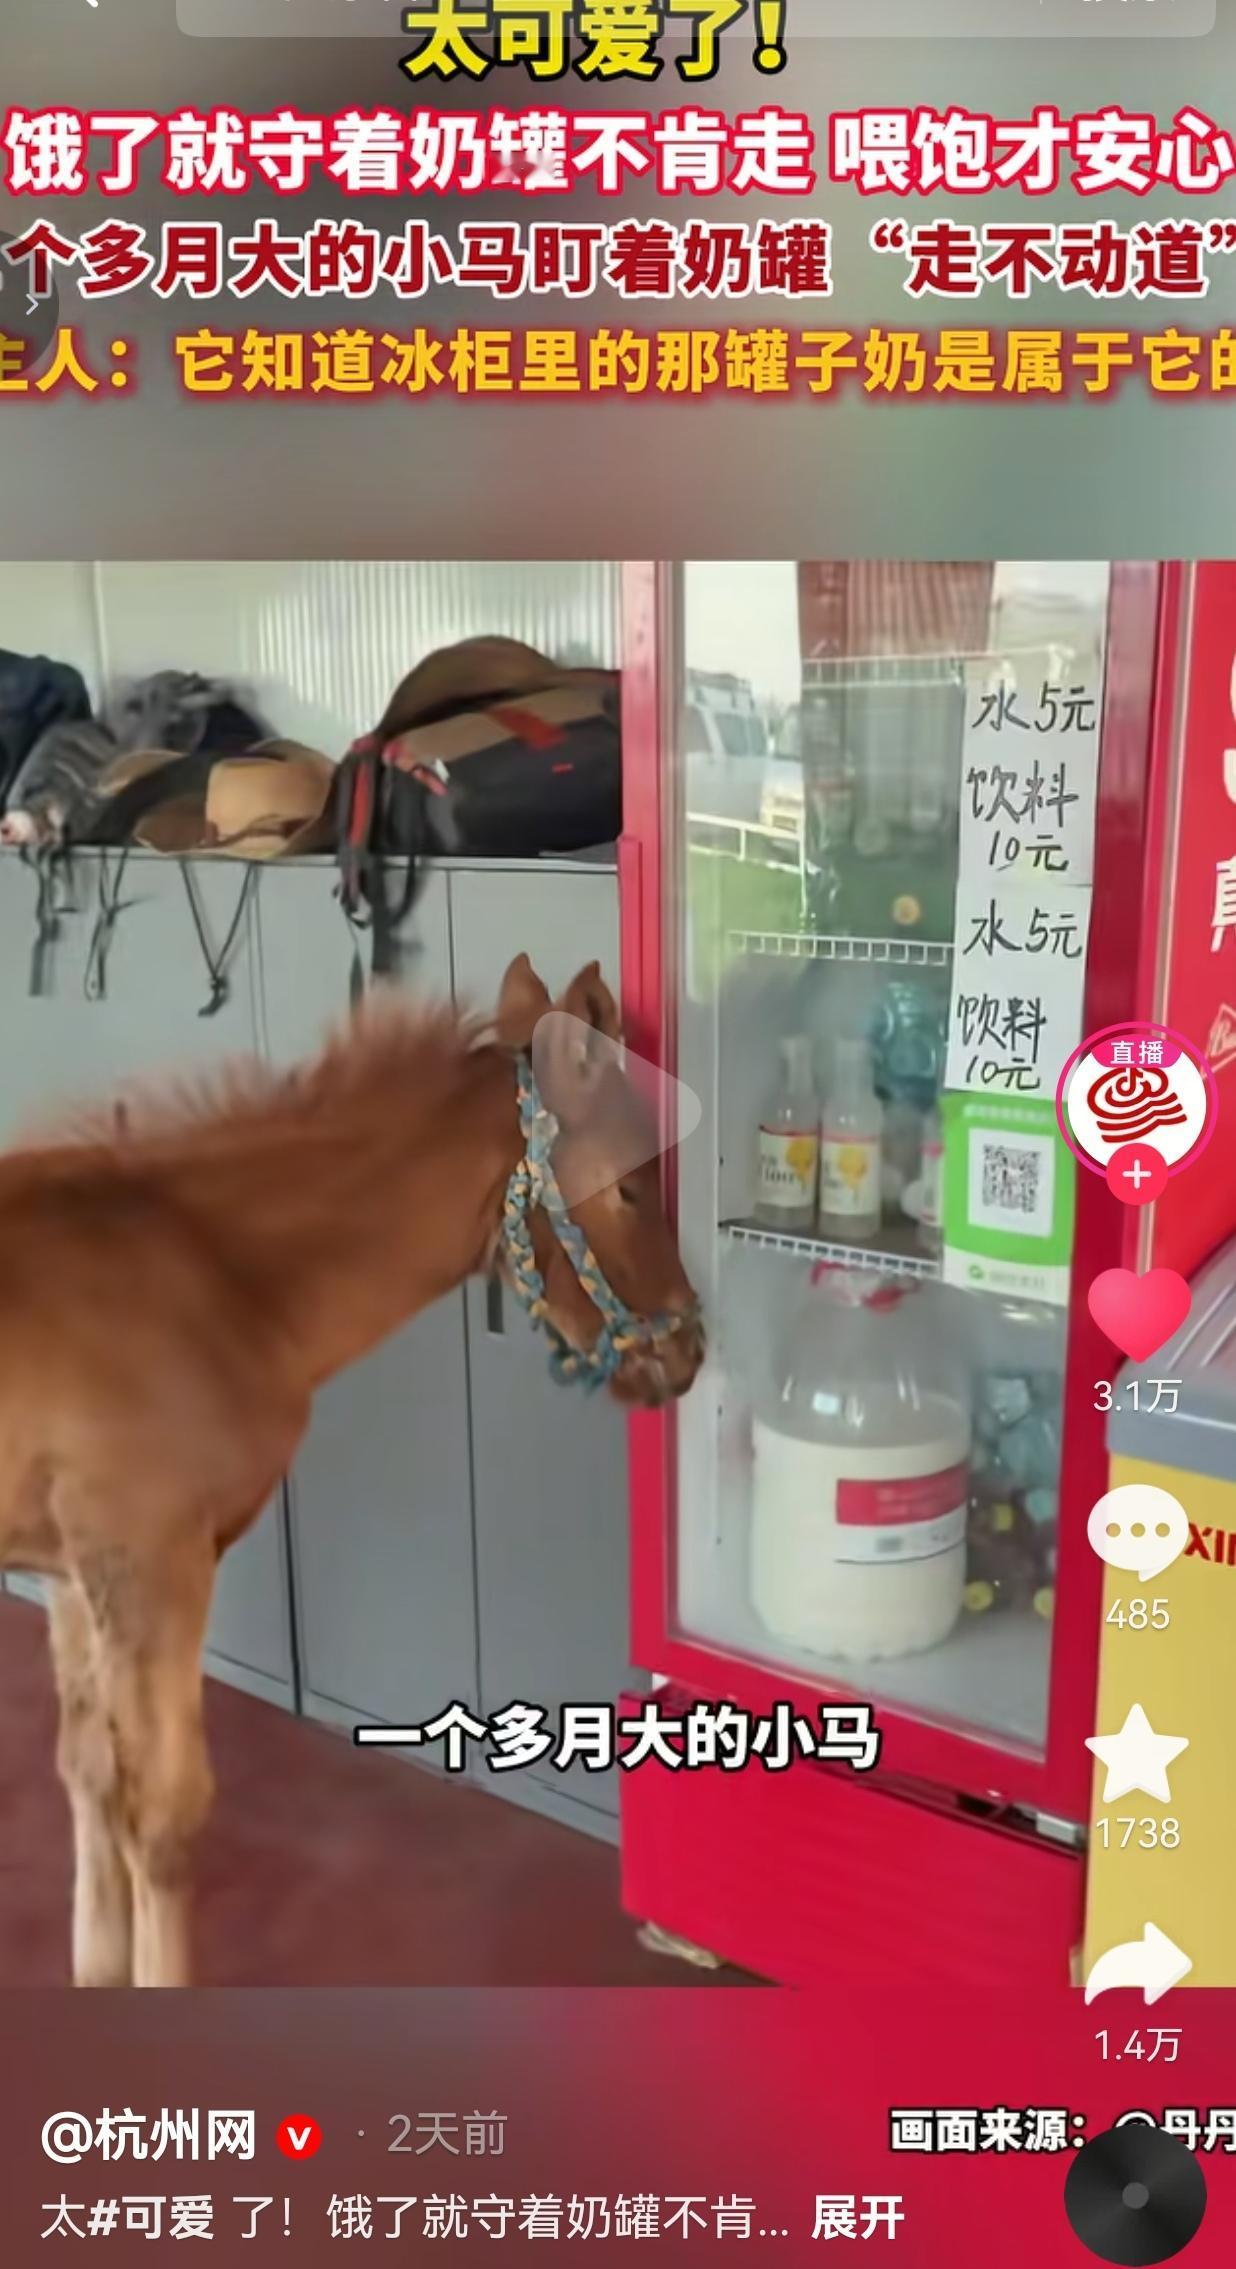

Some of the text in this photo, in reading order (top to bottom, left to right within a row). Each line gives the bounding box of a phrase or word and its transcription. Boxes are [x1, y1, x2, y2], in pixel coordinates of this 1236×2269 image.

[966, 760, 1079, 828] 饮料
[989, 830, 1069, 871] 10元
[957, 993, 1047, 1062] 饮料
[966, 1056, 1040, 1090] 10元
